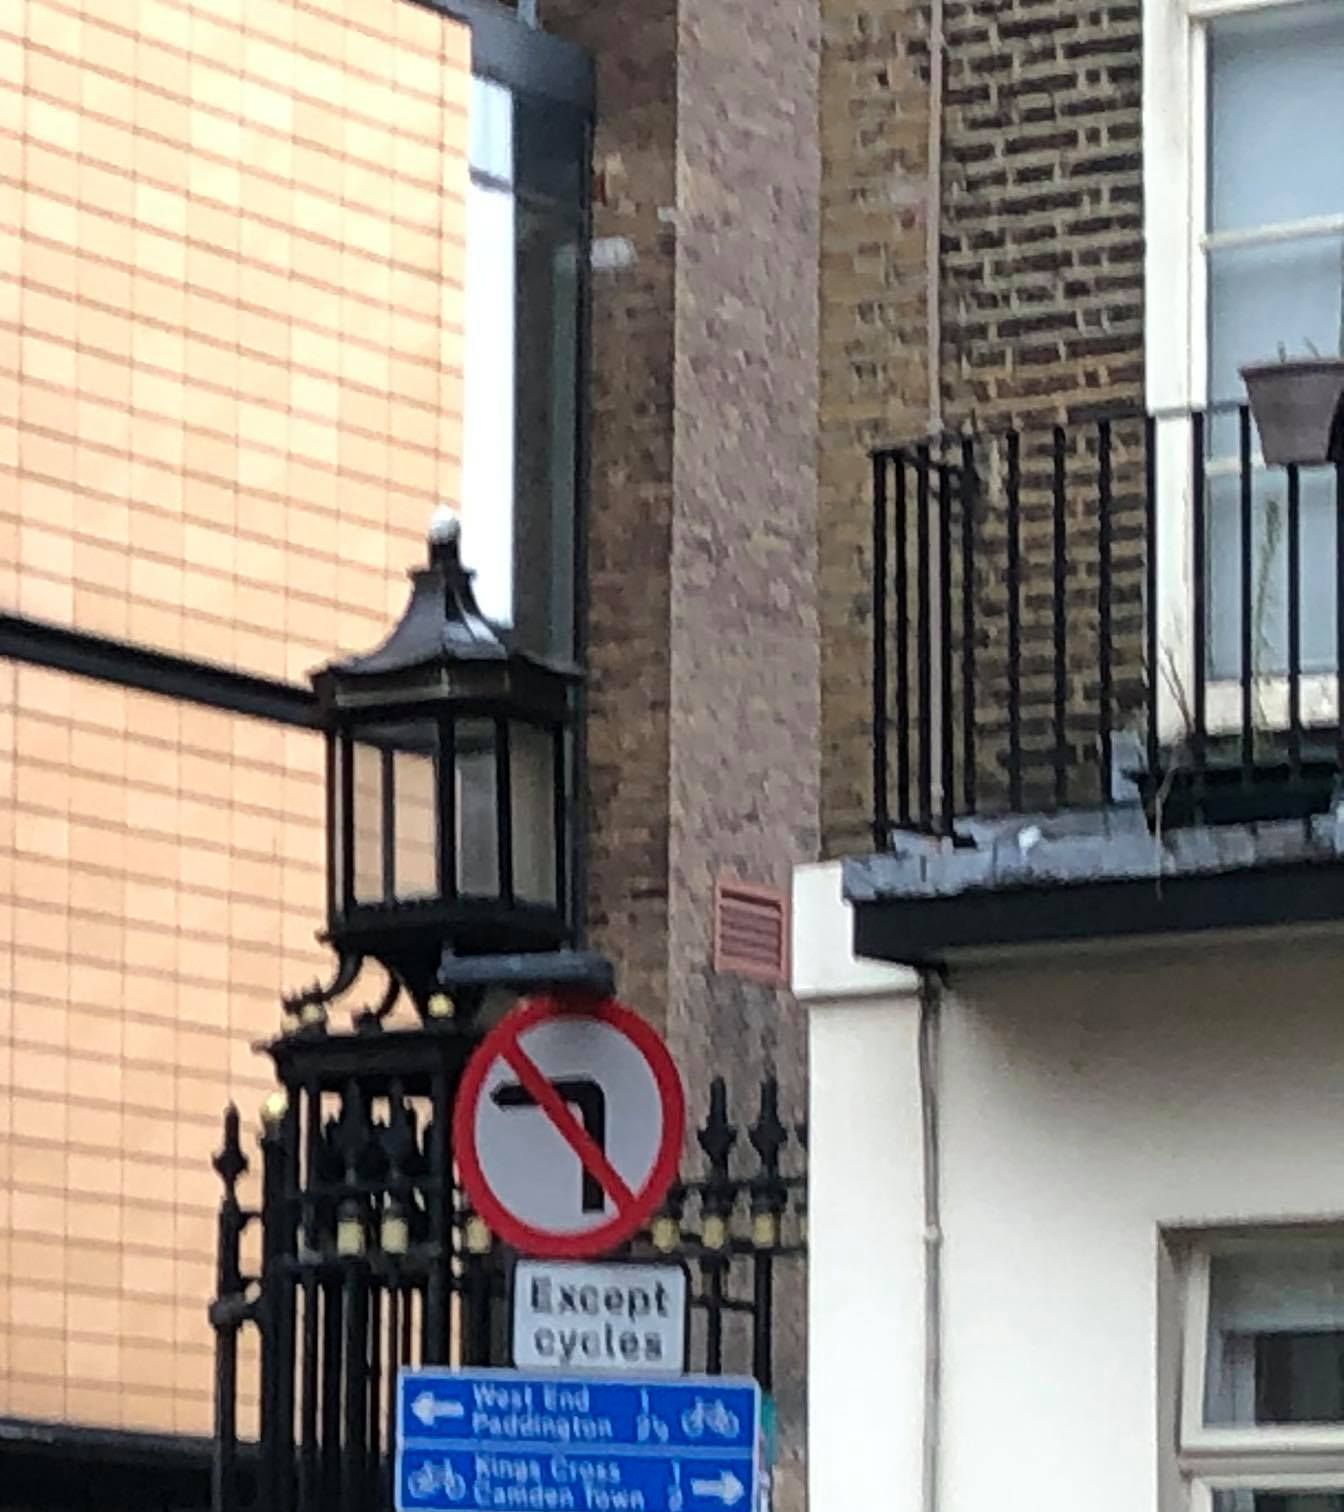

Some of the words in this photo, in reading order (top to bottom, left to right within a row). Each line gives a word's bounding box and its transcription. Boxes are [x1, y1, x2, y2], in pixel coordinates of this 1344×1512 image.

[531, 1276, 669, 1323] Except
[533, 1321, 663, 1367] cycles
[472, 1383, 533, 1410] West
[543, 1384, 590, 1413] End
[472, 1411, 613, 1441] Paddington
[551, 1454, 621, 1484] Cross
[473, 1478, 575, 1508] Camden
[581, 1481, 646, 1511] Town
